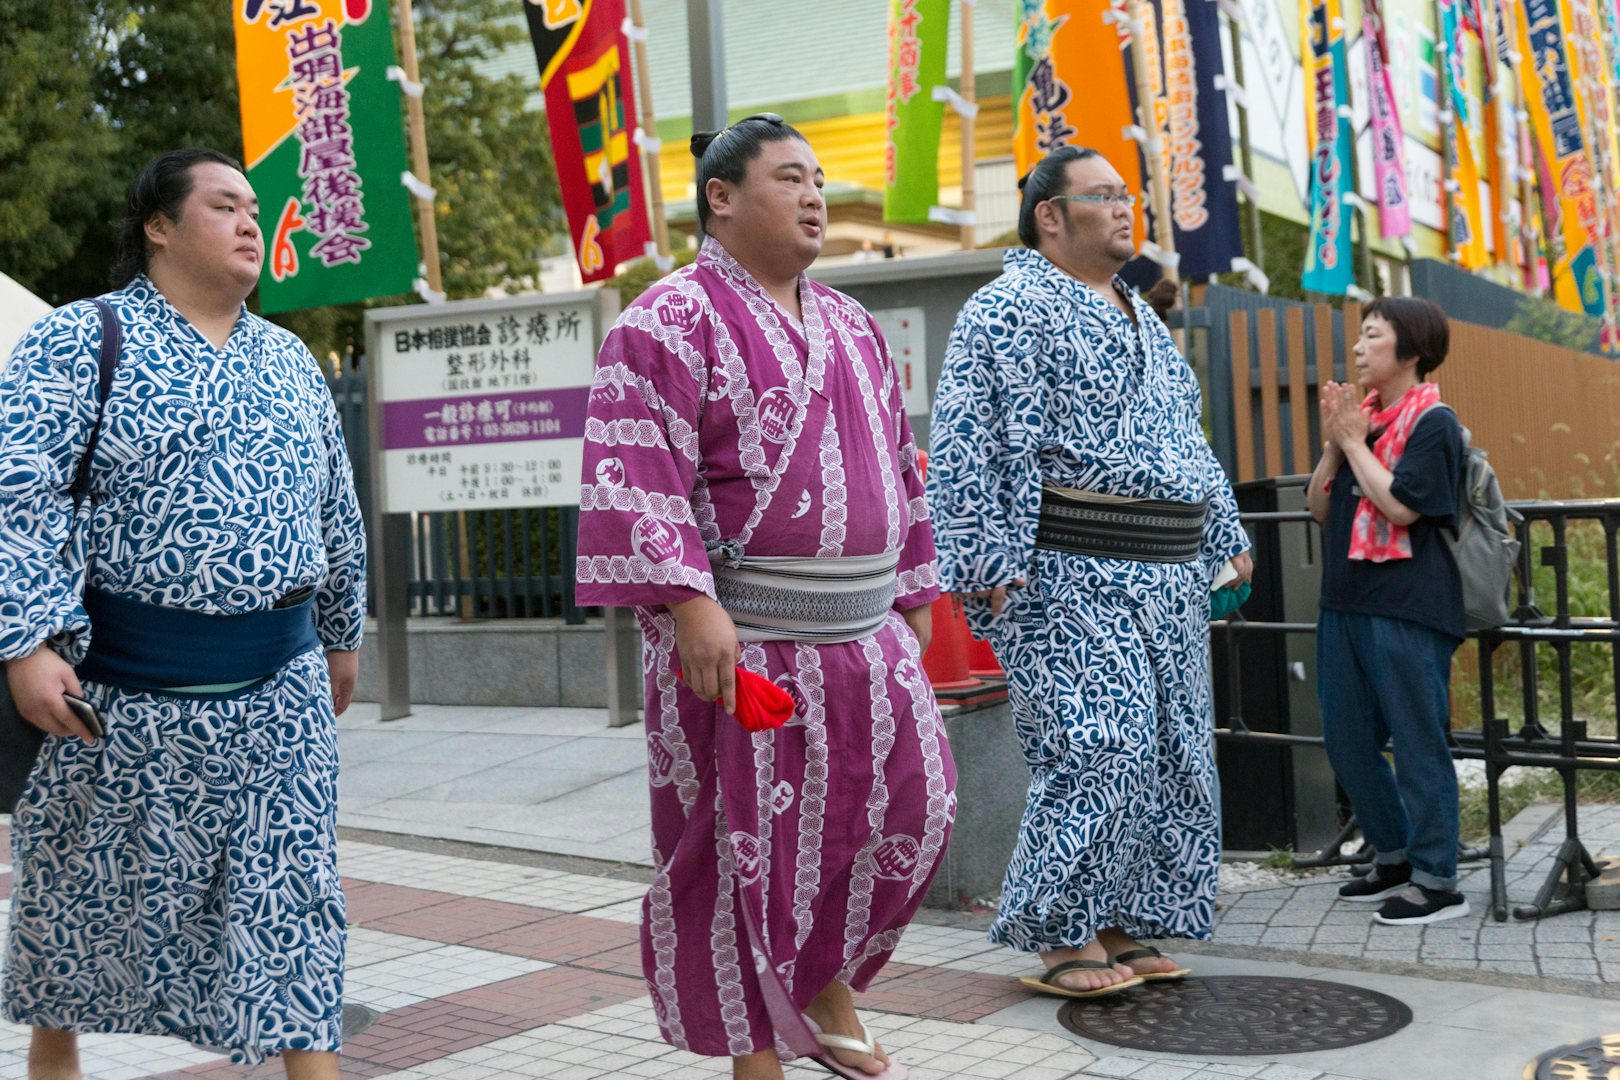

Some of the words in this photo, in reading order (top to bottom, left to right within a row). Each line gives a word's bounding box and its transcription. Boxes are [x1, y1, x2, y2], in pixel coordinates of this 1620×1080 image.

[289, 20, 370, 264] 出羽海部屋後援会
[395, 322, 491, 354] 日本相撲協会
[496, 310, 582, 347] 診療所
[447, 347, 531, 376] 整形外科
